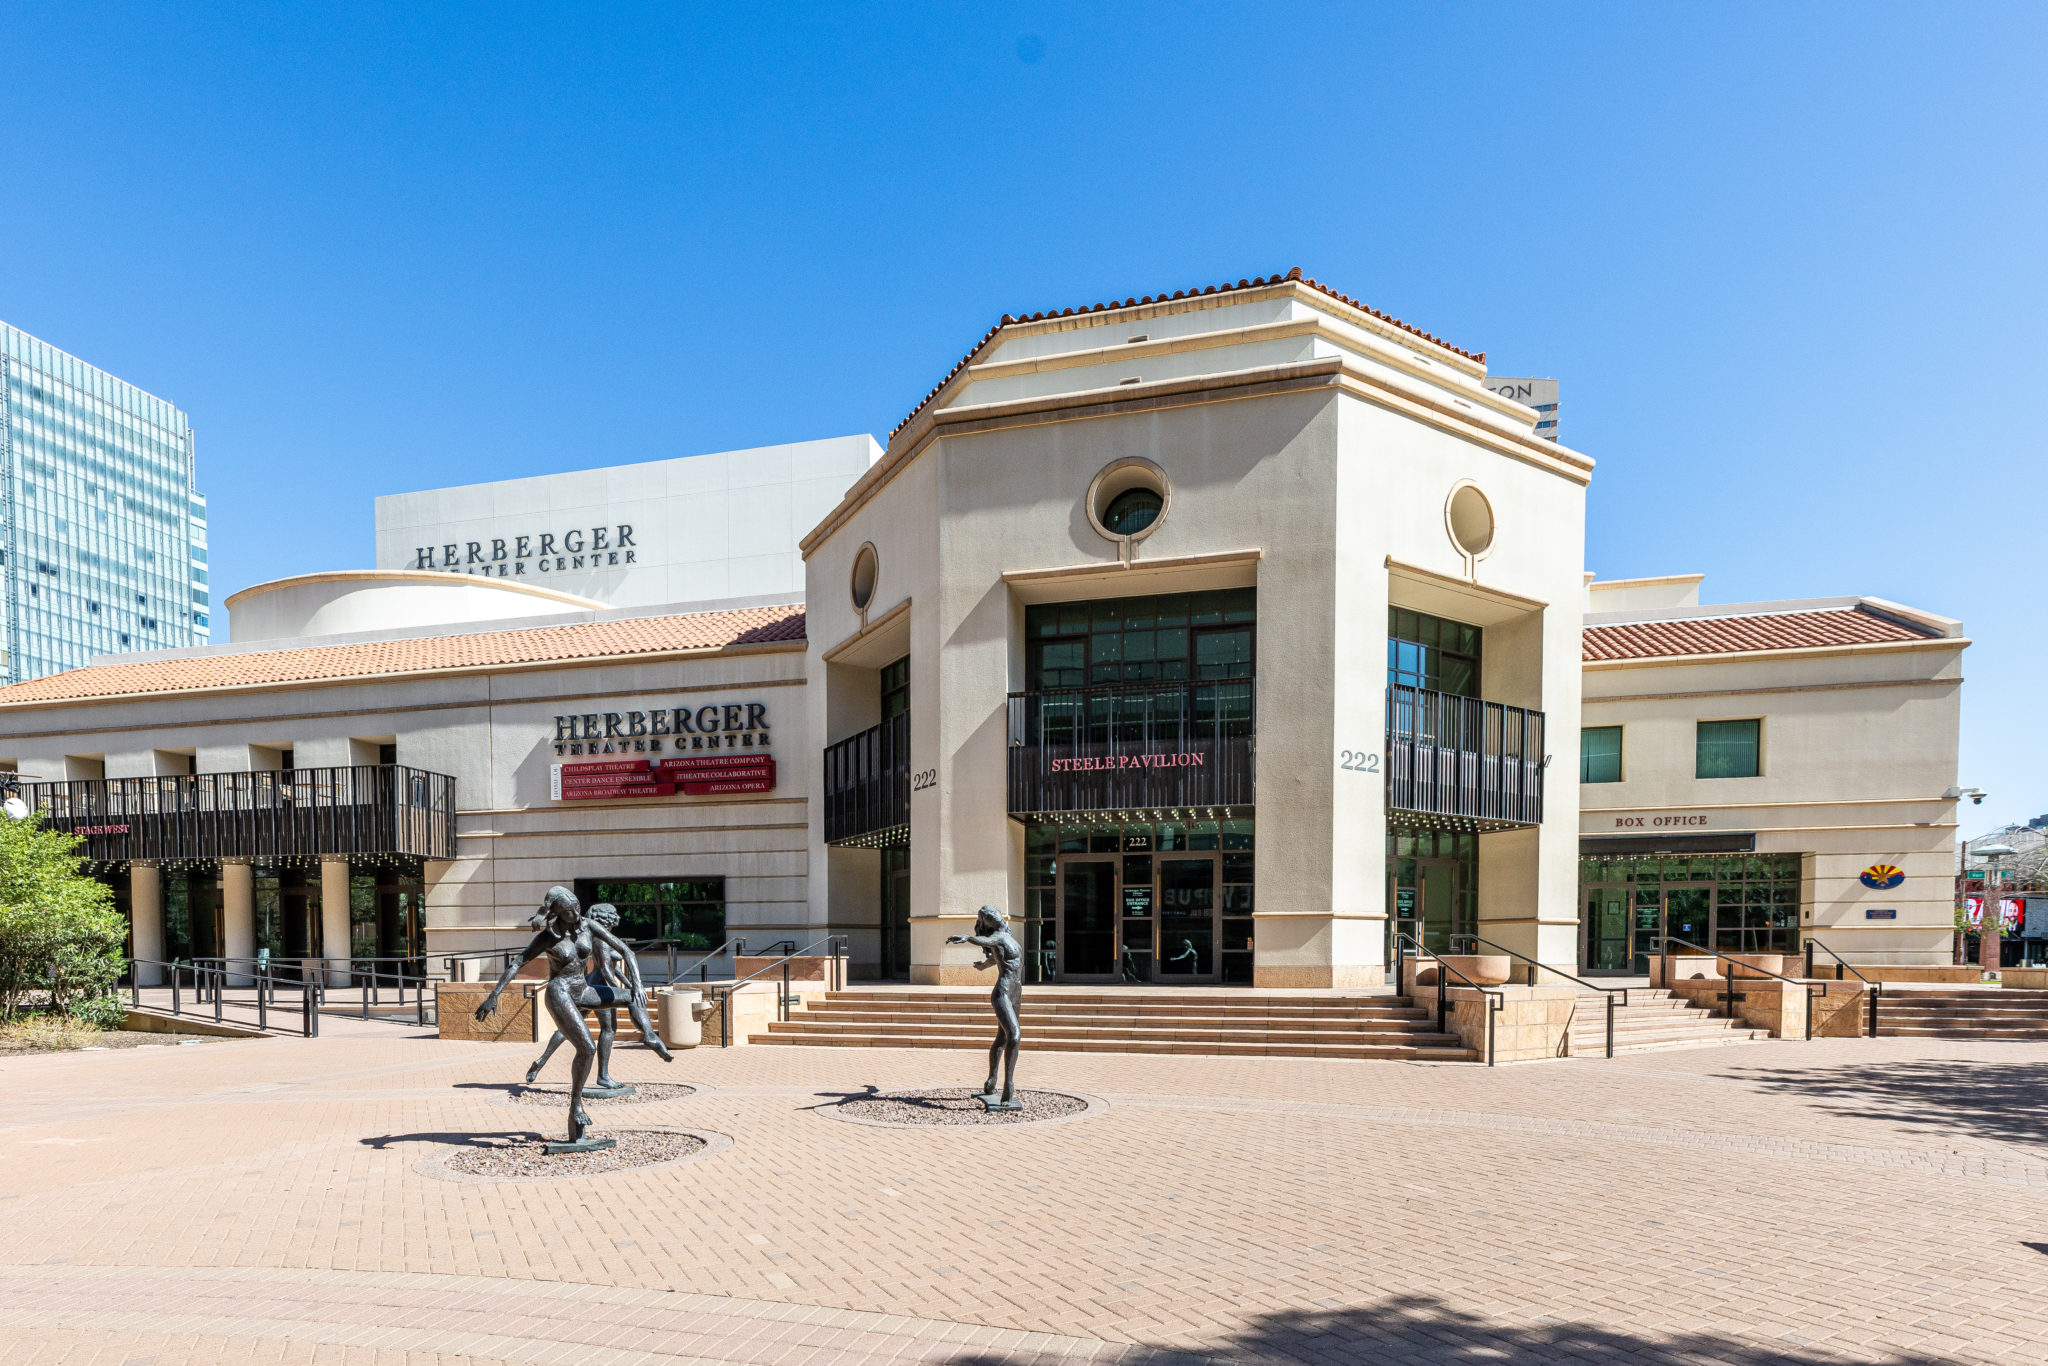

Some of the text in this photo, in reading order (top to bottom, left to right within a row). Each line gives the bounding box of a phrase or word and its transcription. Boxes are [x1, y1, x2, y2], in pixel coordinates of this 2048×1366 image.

[416, 524, 637, 569] HERBERGER
[539, 551, 637, 572] CENTER
[554, 703, 770, 741] HERBERGER
[554, 733, 770, 756] THEATER CENTER
[696, 758, 729, 766] THEATRE
[729, 756, 765, 764] COMPANY
[1051, 752, 1205, 772] STEELE PAVILION
[1340, 749, 1380, 773] 222
[564, 763, 635, 773] CHILDSPLAY THEATRE
[710, 769, 767, 778] COLLABORATIVE
[564, 774, 652, 785] CENTER DANCE ENSEMBLE
[913, 768, 937, 791] 222
[566, 790, 593, 798] ARIZONA
[629, 787, 658, 795] THEATRE
[710, 782, 765, 792] ARIZONA OPERA
[1615, 815, 1708, 827] BOX OFFICE
[74, 824, 130, 835] STAGE WEST
[1129, 837, 1147, 846] 222
